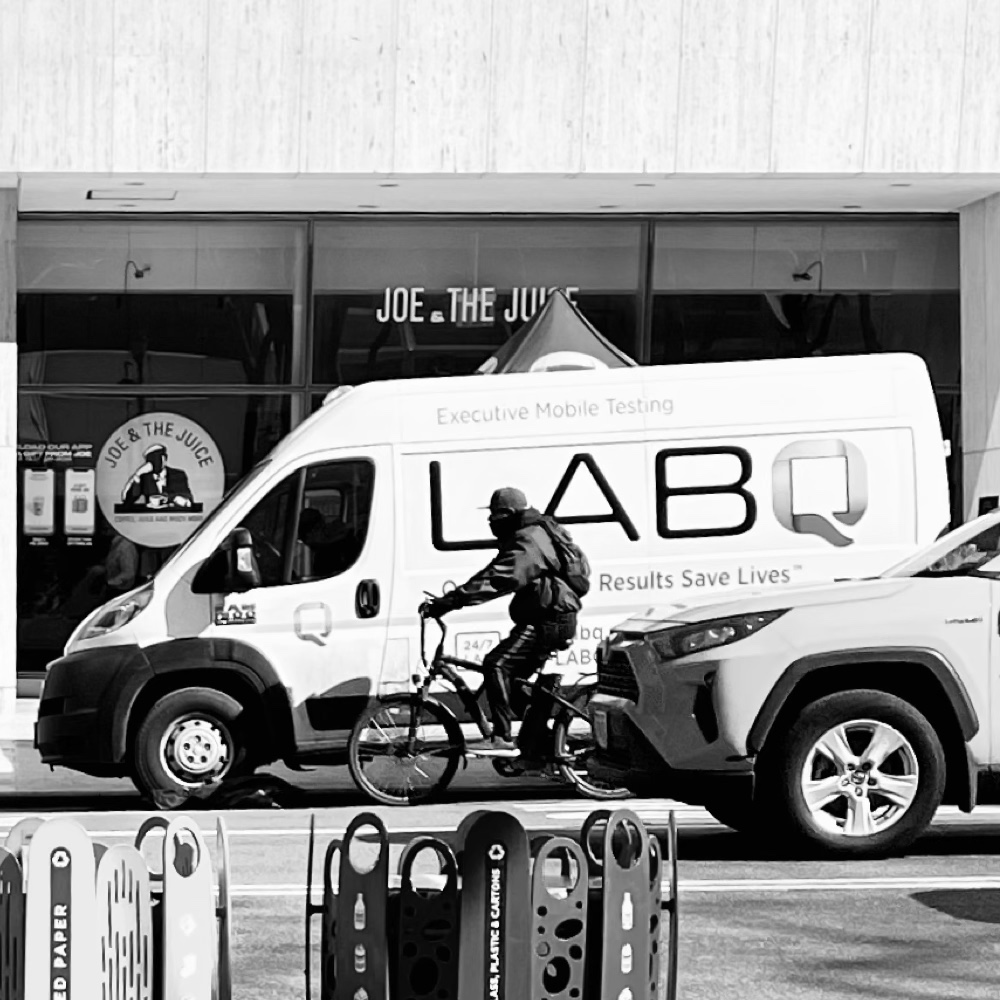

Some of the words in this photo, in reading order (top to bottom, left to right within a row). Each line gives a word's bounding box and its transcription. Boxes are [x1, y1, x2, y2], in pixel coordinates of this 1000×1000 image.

[376, 287, 424, 322] JOE
[447, 287, 494, 322] THE
[437, 404, 529, 425] Executive
[536, 400, 600, 418] Mobile
[606, 397, 674, 415] Testing
[105, 437, 130, 469] JOE
[127, 427, 142, 443] &
[142, 421, 175, 437] THE
[175, 429, 215, 468] JUICE
[429, 438, 869, 551] LABQ
[599, 570, 673, 591] Results
[681, 568, 731, 588] Save
[463, 639, 493, 651] 24/7
[490, 868, 501, 919] CARTONS
[53, 904, 68, 968] PAPER
[489, 930, 500, 973] PLASTIC
